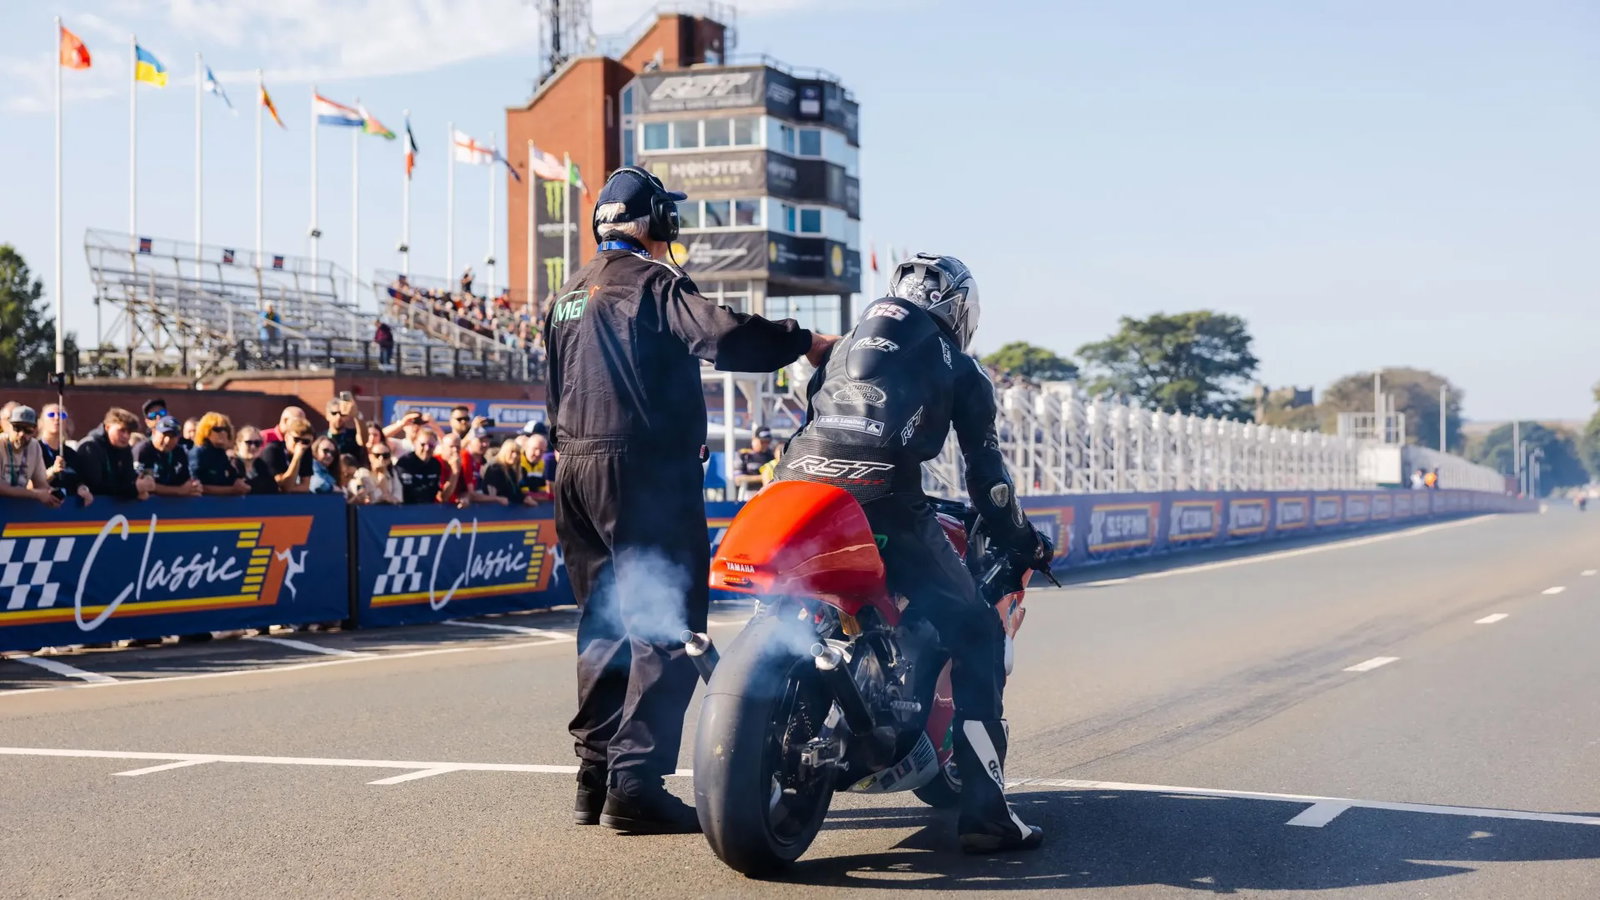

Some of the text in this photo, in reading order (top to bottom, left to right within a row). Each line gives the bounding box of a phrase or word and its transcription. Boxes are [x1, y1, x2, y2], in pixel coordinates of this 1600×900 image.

[787, 455, 896, 479] RST
[74, 513, 243, 632] Classic
[429, 517, 528, 611] Classic
[725, 561, 756, 574] YAMAHA
